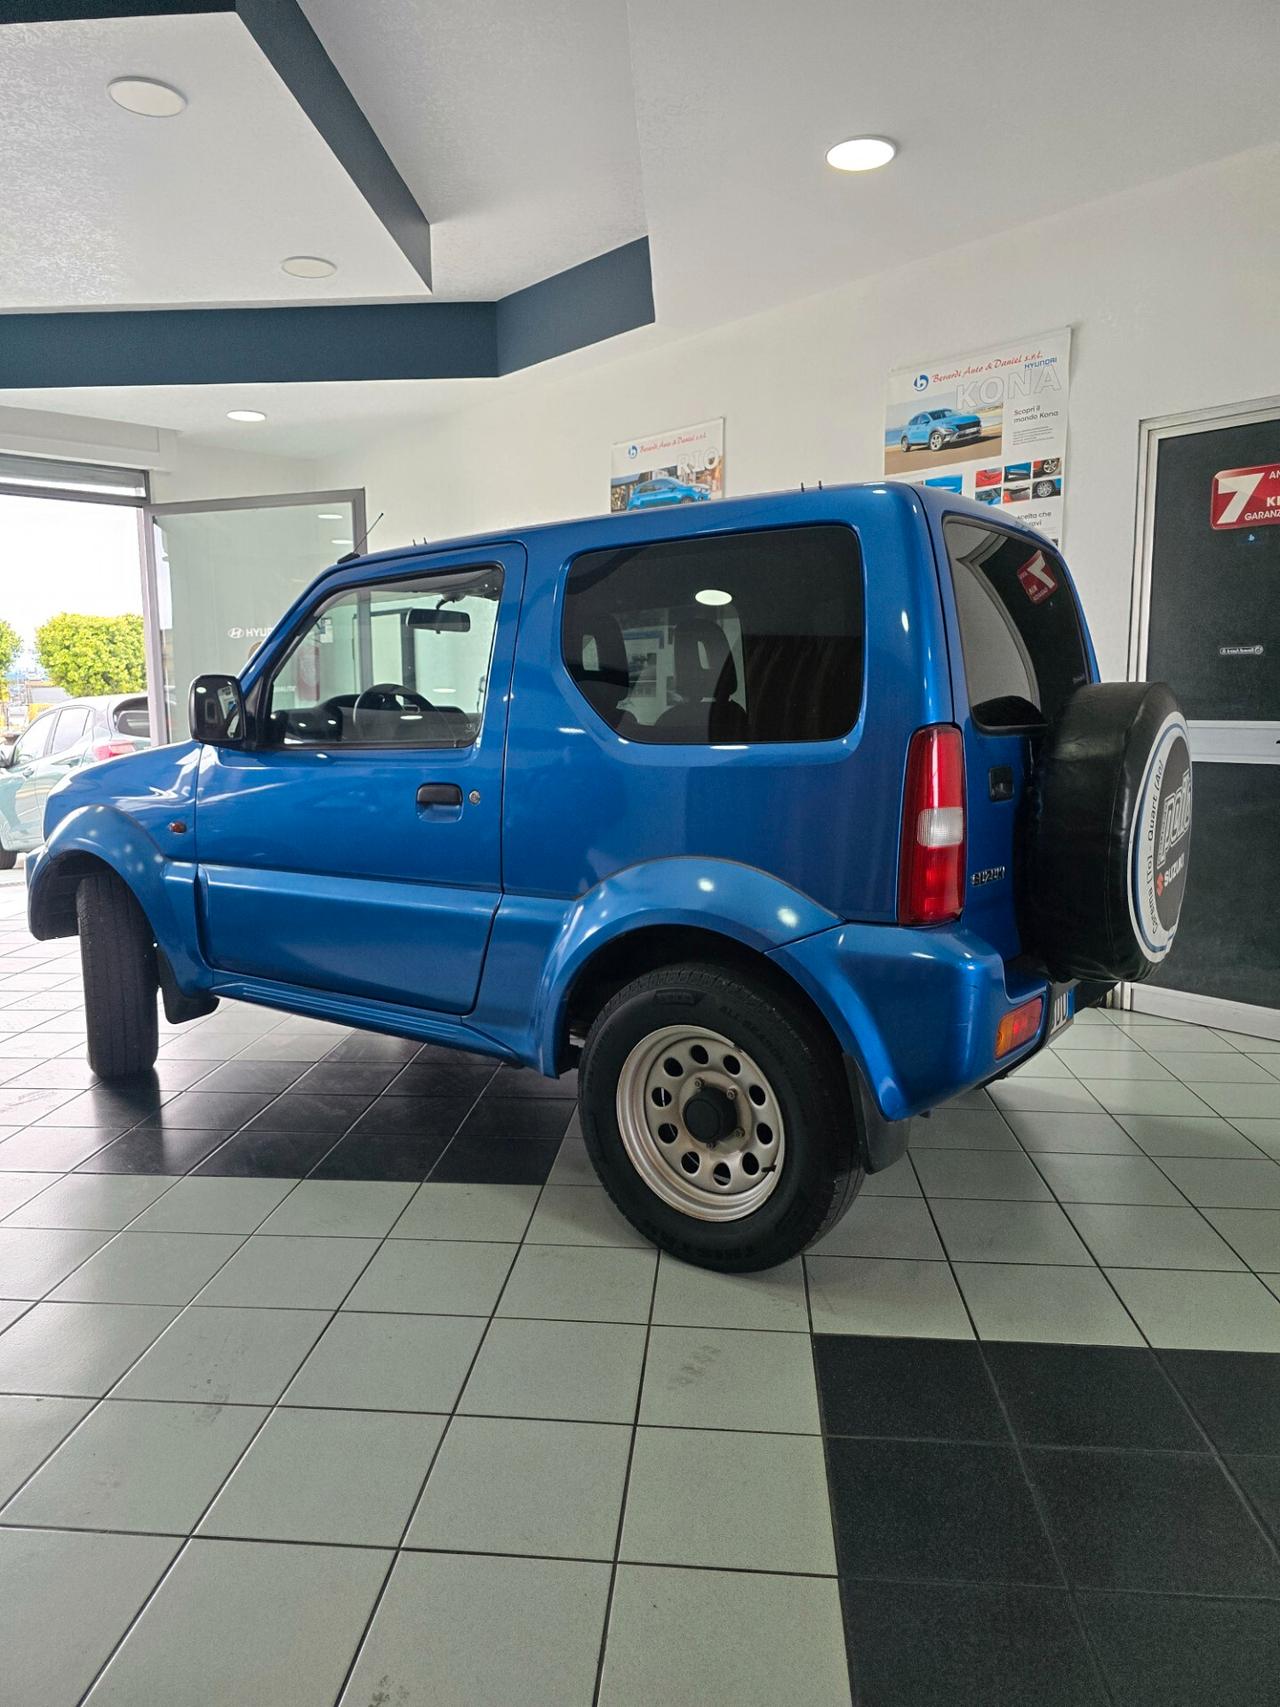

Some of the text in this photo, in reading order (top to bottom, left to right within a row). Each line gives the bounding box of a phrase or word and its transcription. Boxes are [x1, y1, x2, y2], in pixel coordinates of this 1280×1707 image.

[985, 362, 993, 371] &
[1024, 357, 1057, 369] HYUNDAI
[956, 365, 1062, 410] KONA
[1013, 406, 1035, 417] Scopri
[1040, 410, 1059, 418] Kona
[1216, 472, 1265, 525] 7
